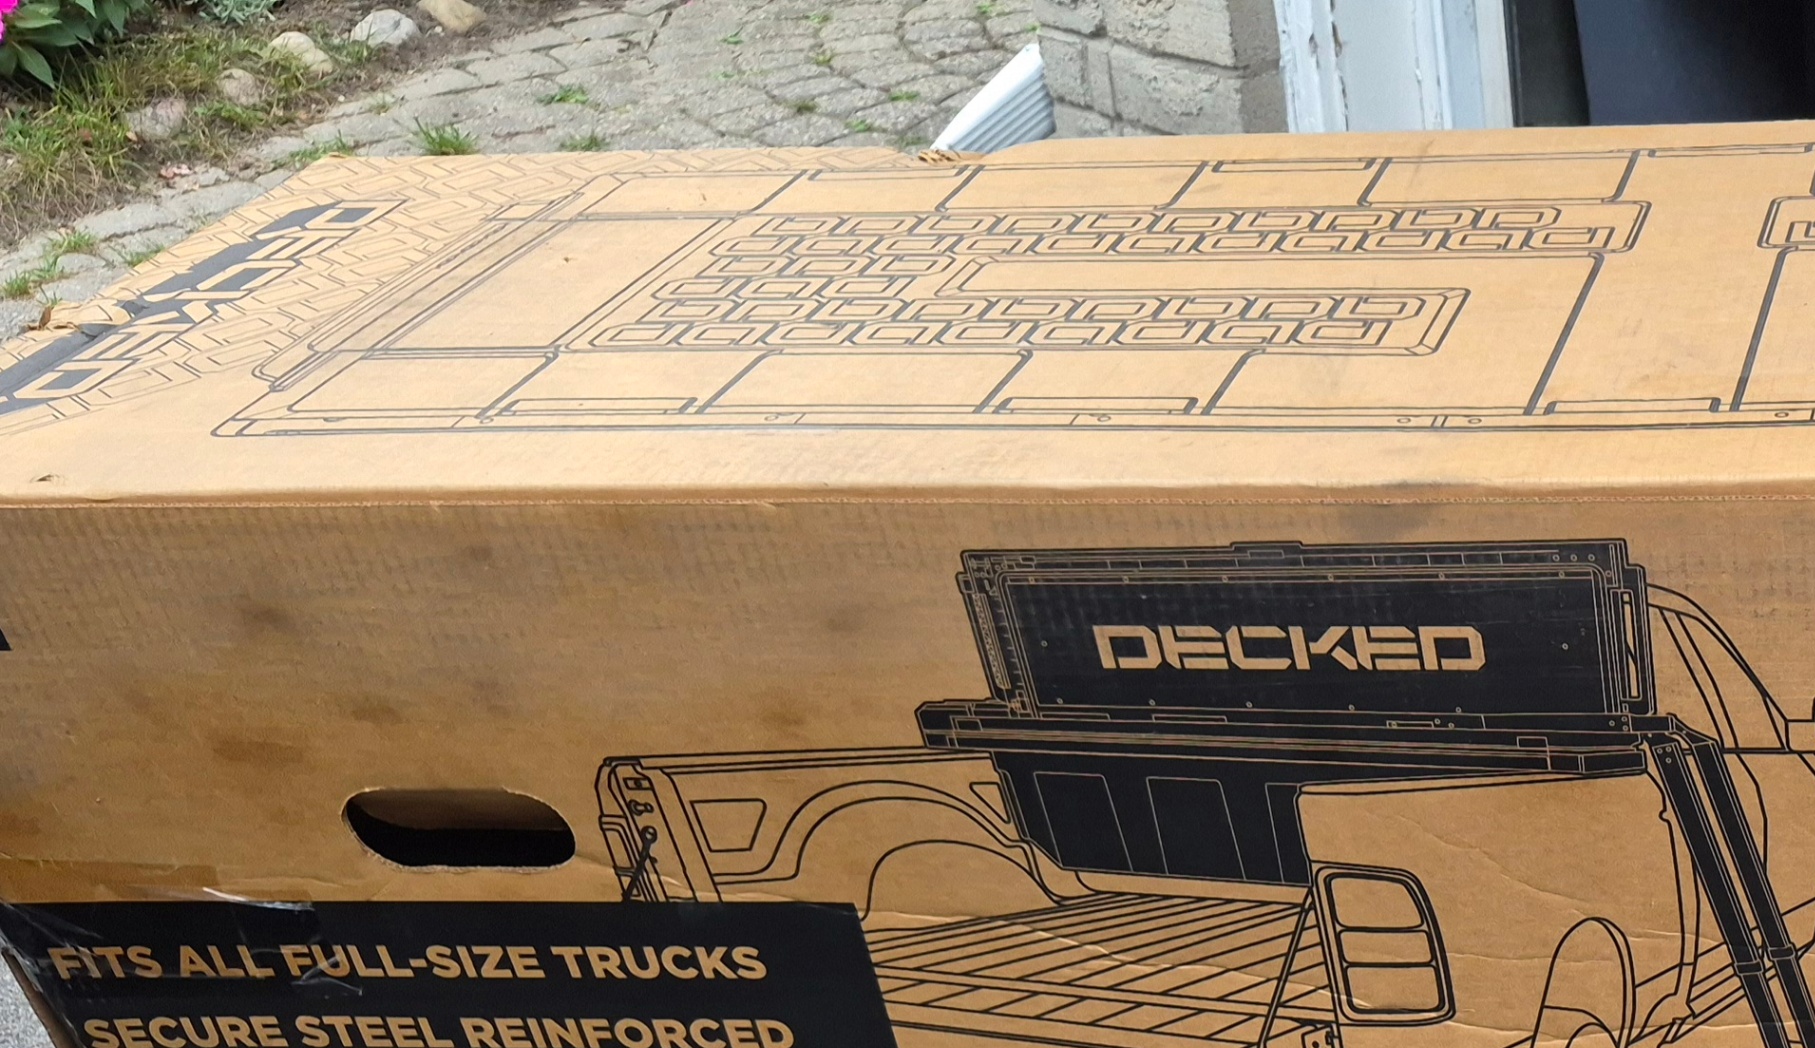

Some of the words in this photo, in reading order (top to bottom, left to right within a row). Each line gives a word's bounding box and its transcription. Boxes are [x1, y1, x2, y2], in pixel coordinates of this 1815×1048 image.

[1092, 624, 1487, 671] DECKED
[48, 945, 162, 980] FITS
[179, 944, 275, 978] ALL
[279, 944, 546, 979] FULL-SIZE
[550, 945, 767, 980] TRUCKS
[295, 1015, 454, 1048] STEEL
